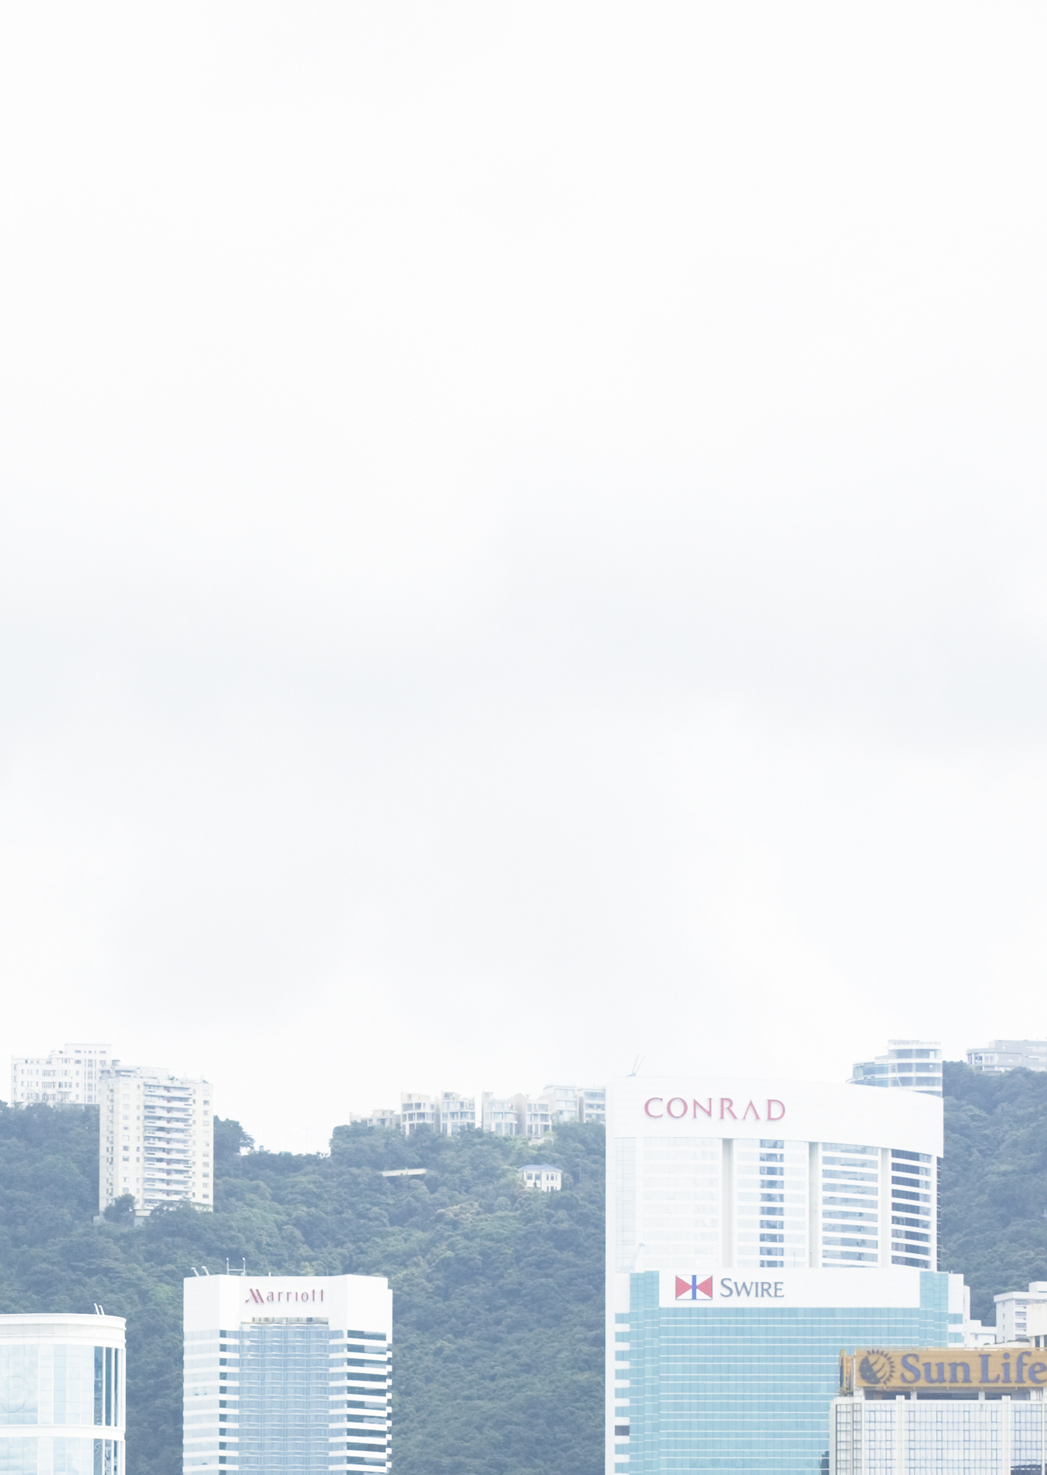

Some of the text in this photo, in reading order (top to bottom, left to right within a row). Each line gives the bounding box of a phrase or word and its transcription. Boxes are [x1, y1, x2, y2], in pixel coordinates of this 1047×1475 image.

[644, 1097, 786, 1121] CONRAD
[245, 1288, 324, 1303] Marriott
[720, 1277, 785, 1298] SWIRE
[900, 1351, 1047, 1384] Sun Life
